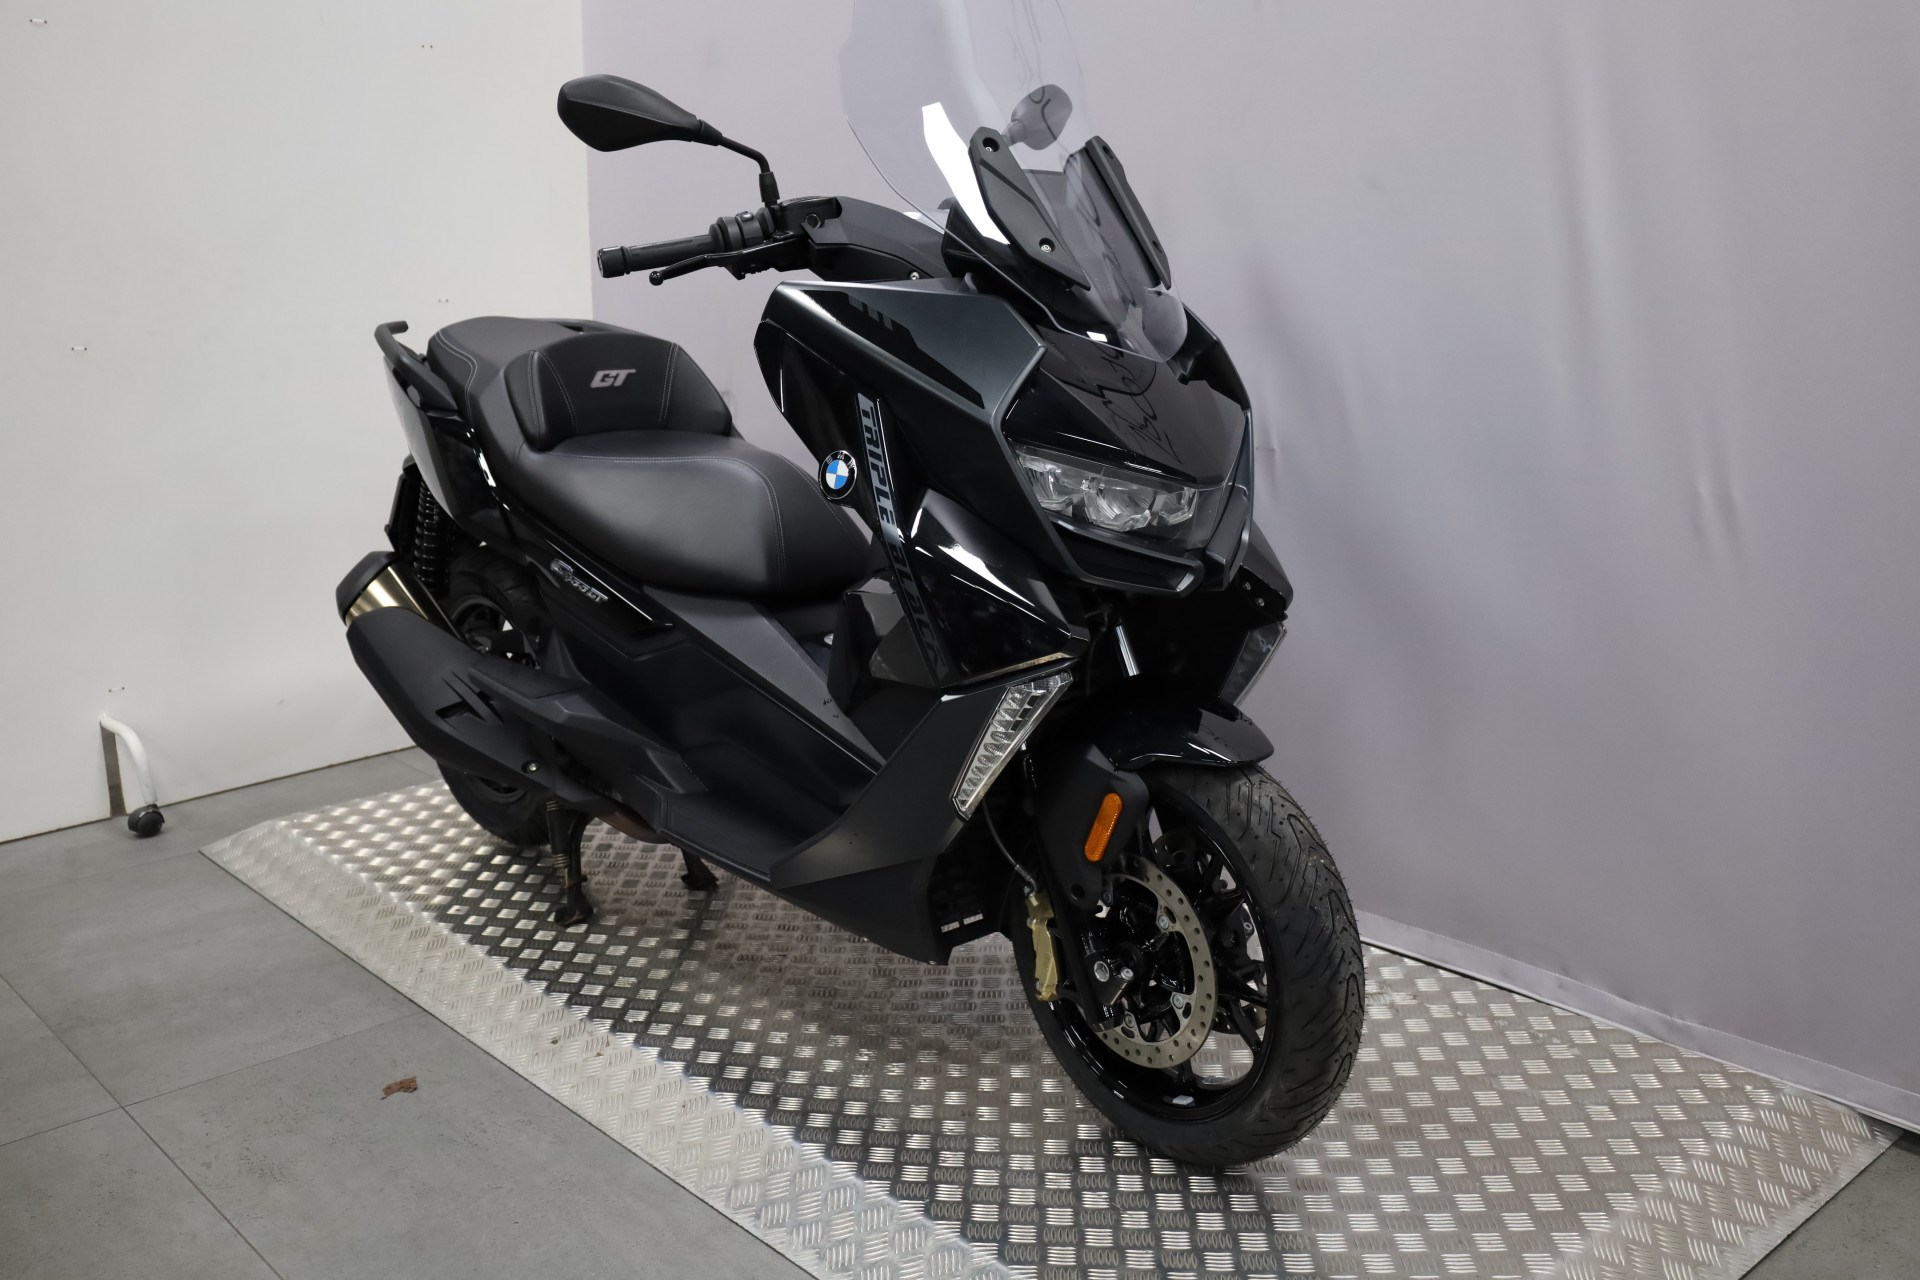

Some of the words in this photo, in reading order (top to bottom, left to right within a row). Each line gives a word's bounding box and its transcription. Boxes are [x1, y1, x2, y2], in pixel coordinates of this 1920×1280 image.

[590, 369, 636, 388] GT
[861, 406, 895, 525] TRIPLE
[886, 541, 946, 668] BLACK
